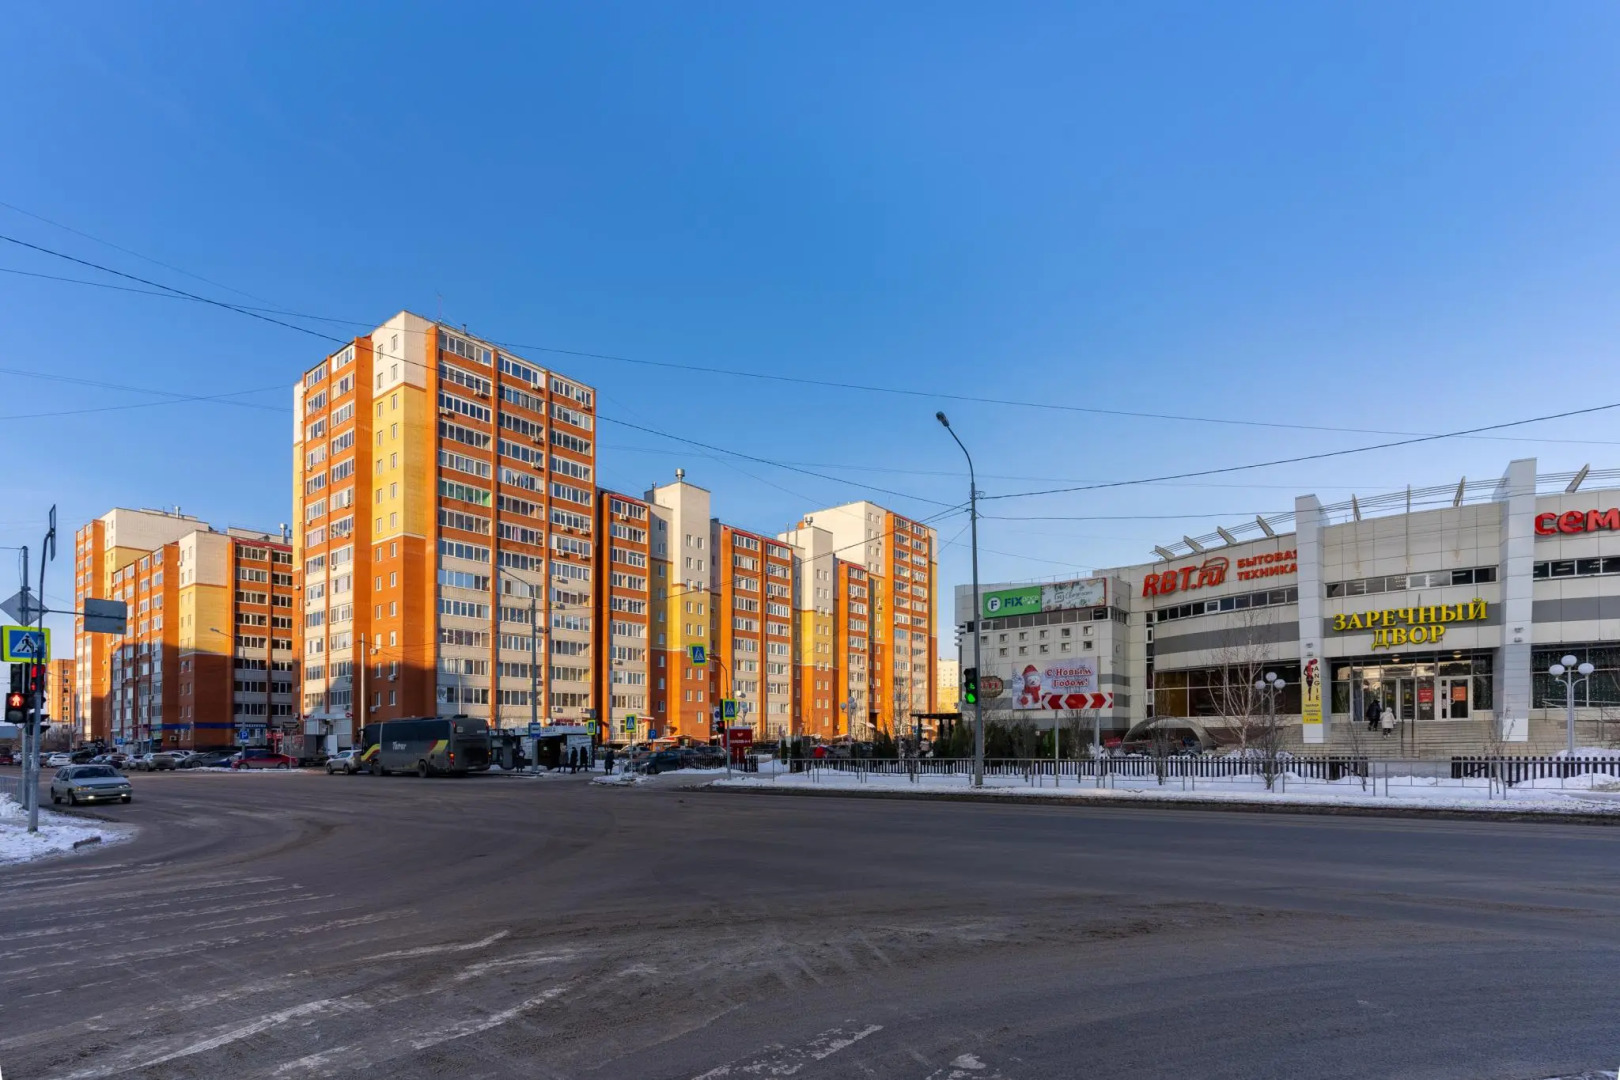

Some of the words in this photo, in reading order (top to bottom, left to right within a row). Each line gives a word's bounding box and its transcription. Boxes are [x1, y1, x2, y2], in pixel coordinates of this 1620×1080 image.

[1142, 565, 1223, 597] RBT.ru
[1237, 563, 1297, 581] ТЕХНИКА
[1332, 598, 1489, 631] ЗАРЕЧНЫЙ
[1371, 624, 1445, 651] ДВОР
[1046, 669, 1053, 677] С
[1056, 667, 1093, 676] Новым
[1053, 678, 1088, 687] Годом!
